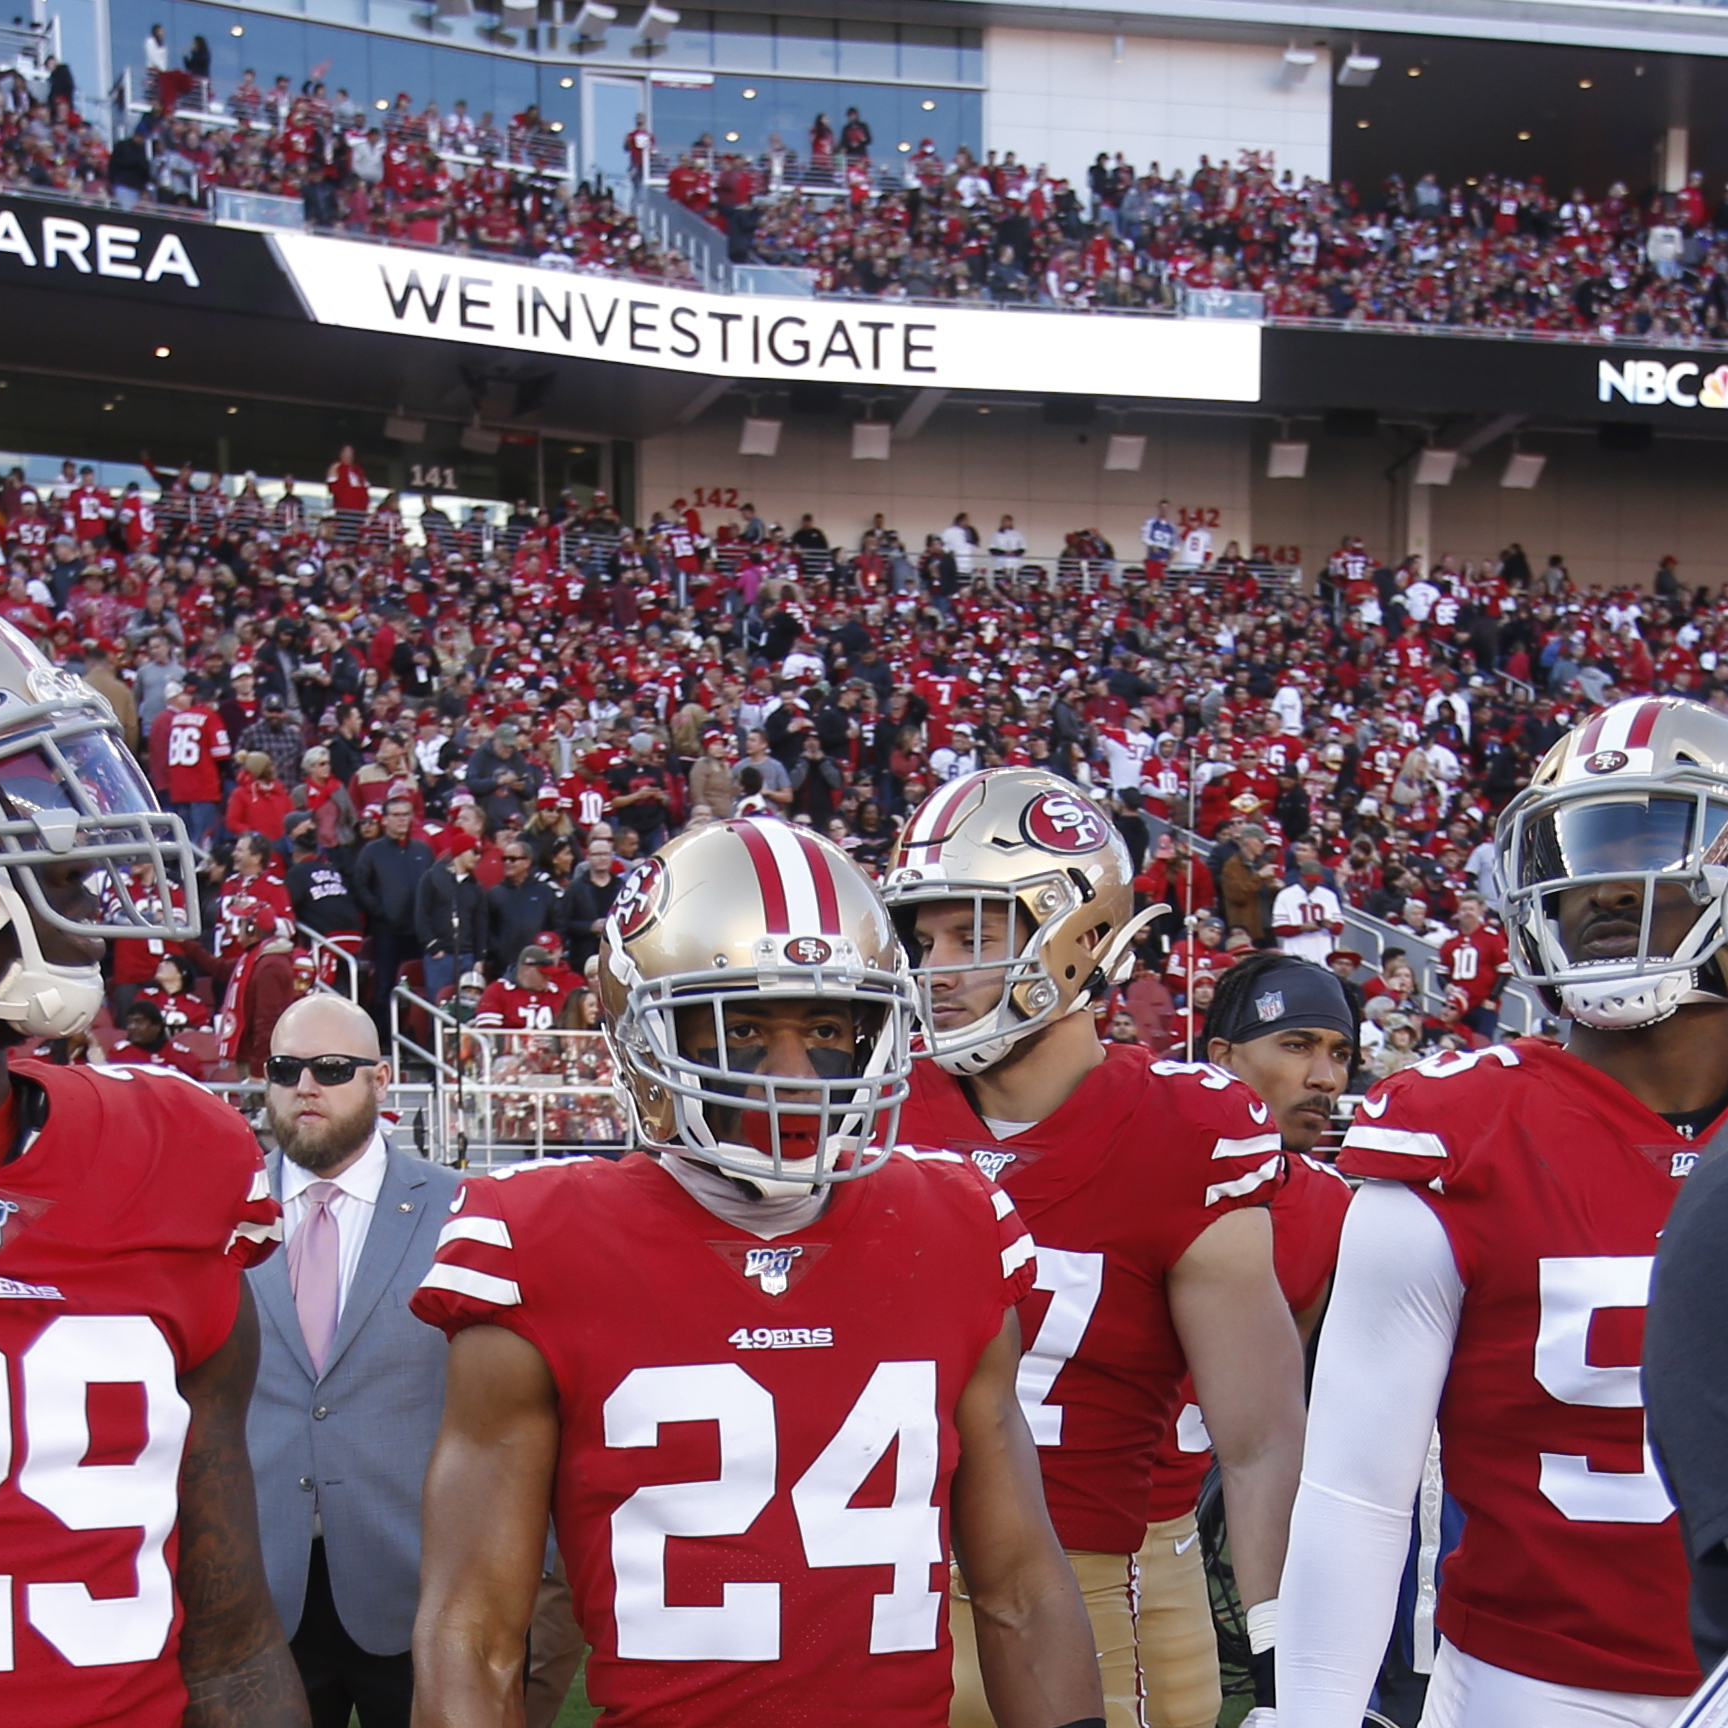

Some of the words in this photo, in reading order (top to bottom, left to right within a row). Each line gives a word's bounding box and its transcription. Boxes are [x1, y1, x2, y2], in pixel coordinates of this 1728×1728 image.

[379, 264, 496, 332] WE
[516, 282, 938, 376] INVESTIGATE
[1598, 357, 1699, 409] NBC
[410, 464, 459, 490] 141
[693, 487, 739, 508] 142
[18, 523, 47, 546] 53
[936, 682, 951, 705] 7
[169, 727, 202, 767] 86
[1158, 771, 1178, 794] 10
[579, 791, 603, 824] 10
[1299, 902, 1325, 923] 10
[1452, 946, 1479, 980] 10
[1258, 1000, 1281, 1019] NFL
[729, 1327, 834, 1350] 49ERS
[604, 1359, 943, 1661] 24
